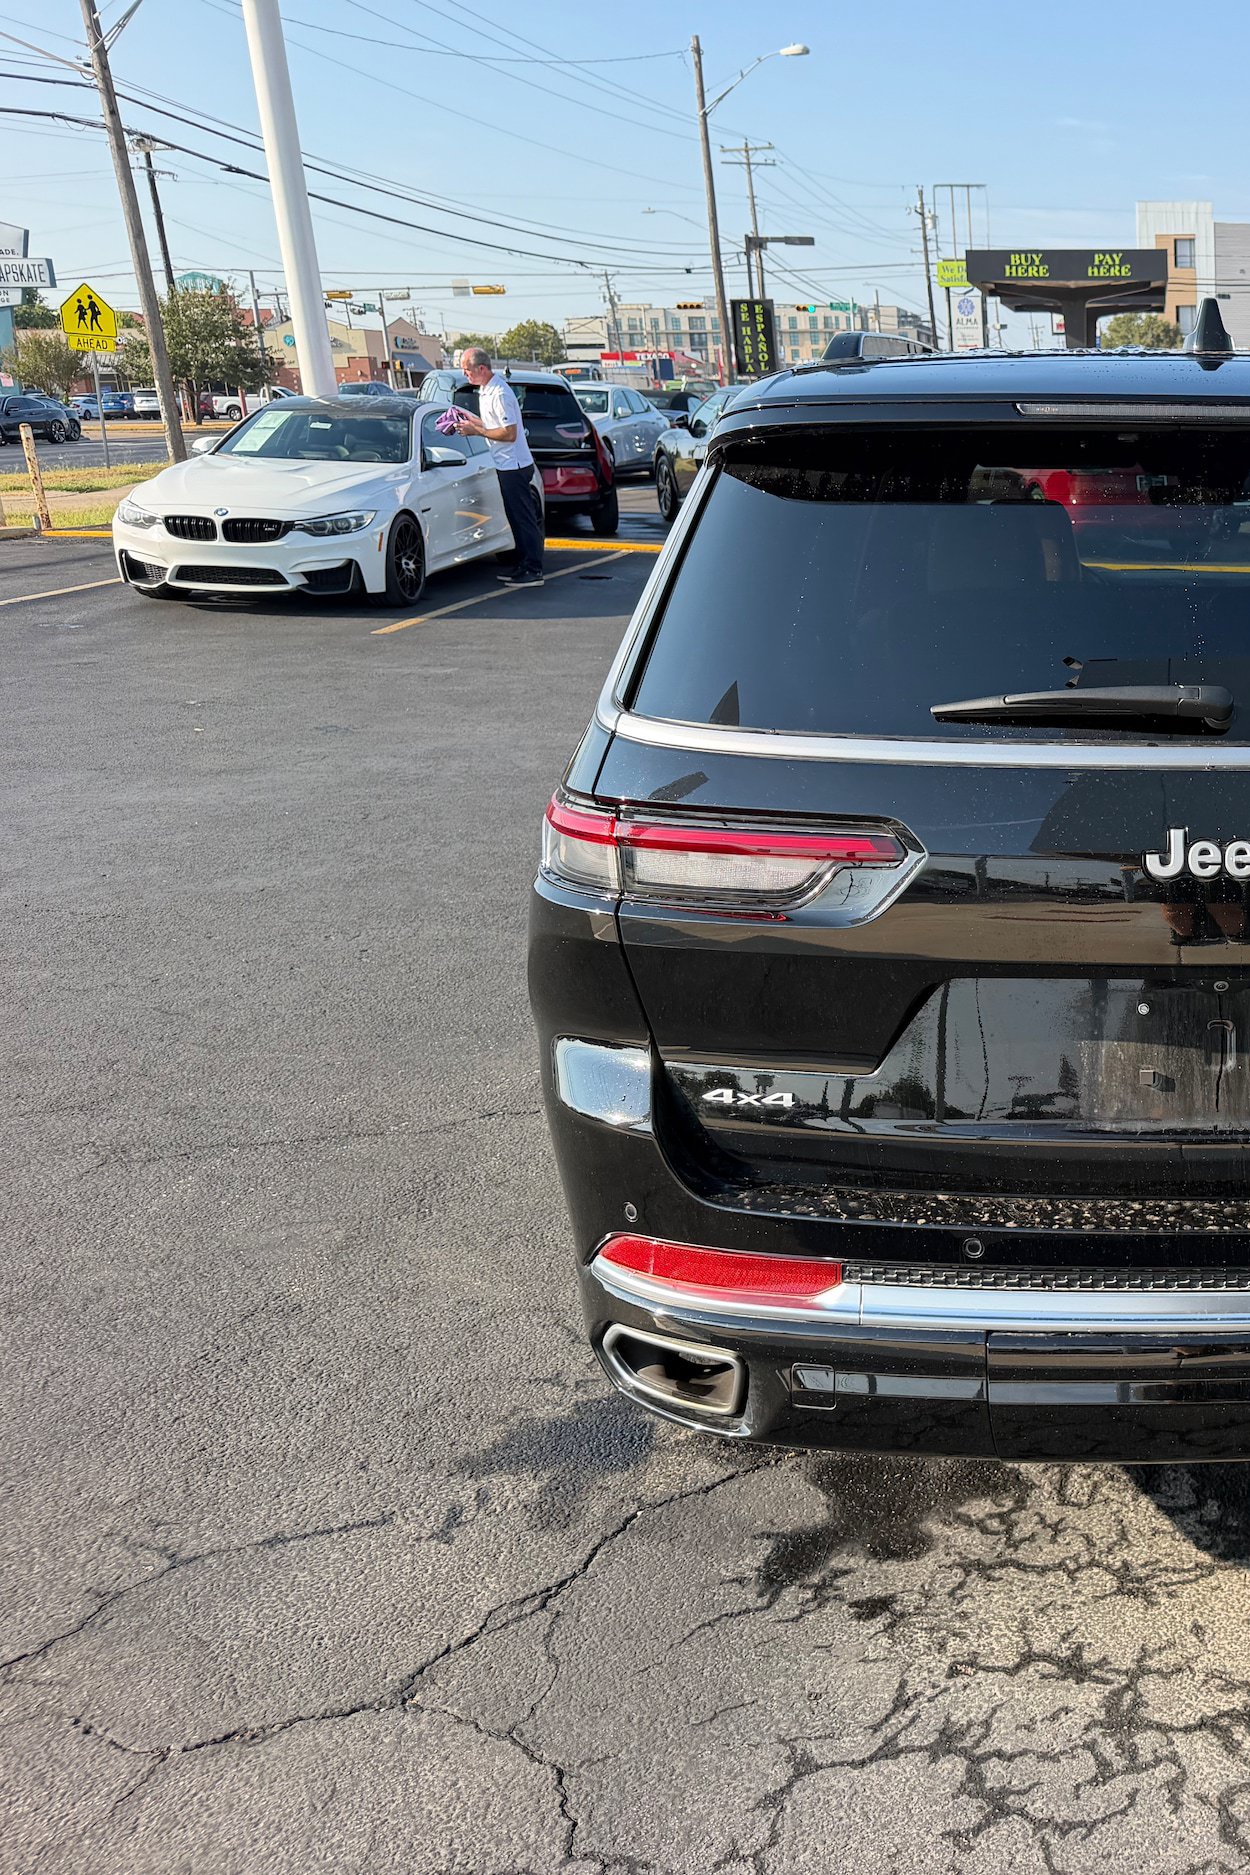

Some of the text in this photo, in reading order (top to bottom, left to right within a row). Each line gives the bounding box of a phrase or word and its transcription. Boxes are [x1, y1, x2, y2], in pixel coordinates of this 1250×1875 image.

[1010, 253, 1043, 265] BUY
[1094, 253, 1123, 265] PAY
[942, 265, 954, 274] We
[1005, 265, 1050, 277] HERE
[1087, 264, 1132, 277] HERE
[956, 317, 978, 326] ALMA
[76, 337, 108, 350] AHEAD
[740, 303, 754, 373] SE HABLA
[701, 1088, 796, 1107] 4x4
